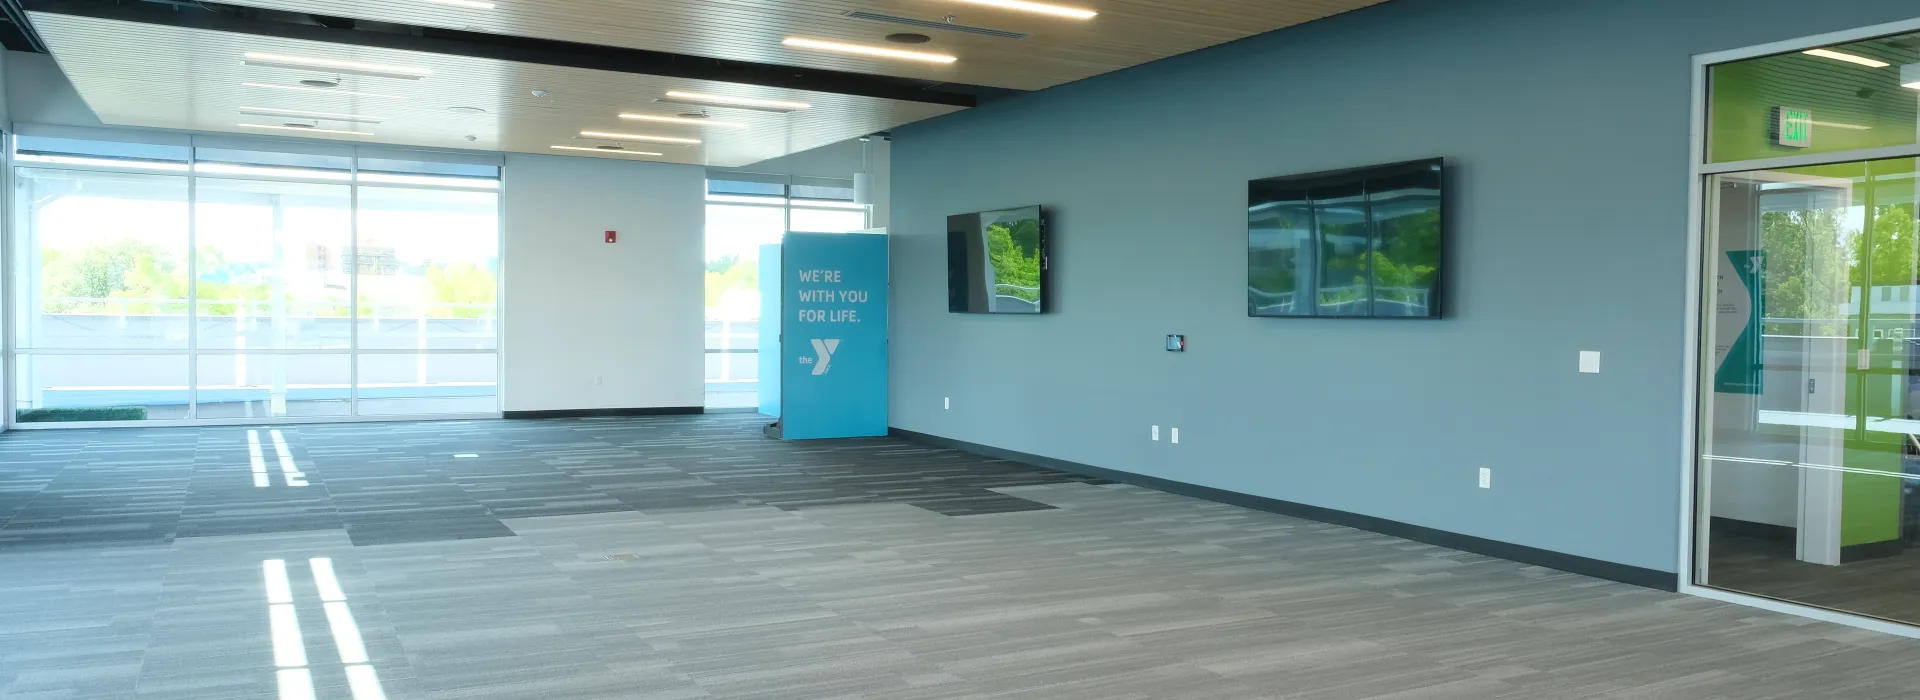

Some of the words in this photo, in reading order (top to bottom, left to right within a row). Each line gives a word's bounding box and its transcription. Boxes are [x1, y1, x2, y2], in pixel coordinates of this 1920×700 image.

[1785, 110, 1808, 141] EXIT
[799, 270, 841, 282] WE'RE
[799, 290, 835, 303] WITH
[839, 290, 868, 303] YOU
[799, 309, 826, 322] FOR
[830, 309, 861, 323] LIFE.
[799, 356, 813, 364] the
